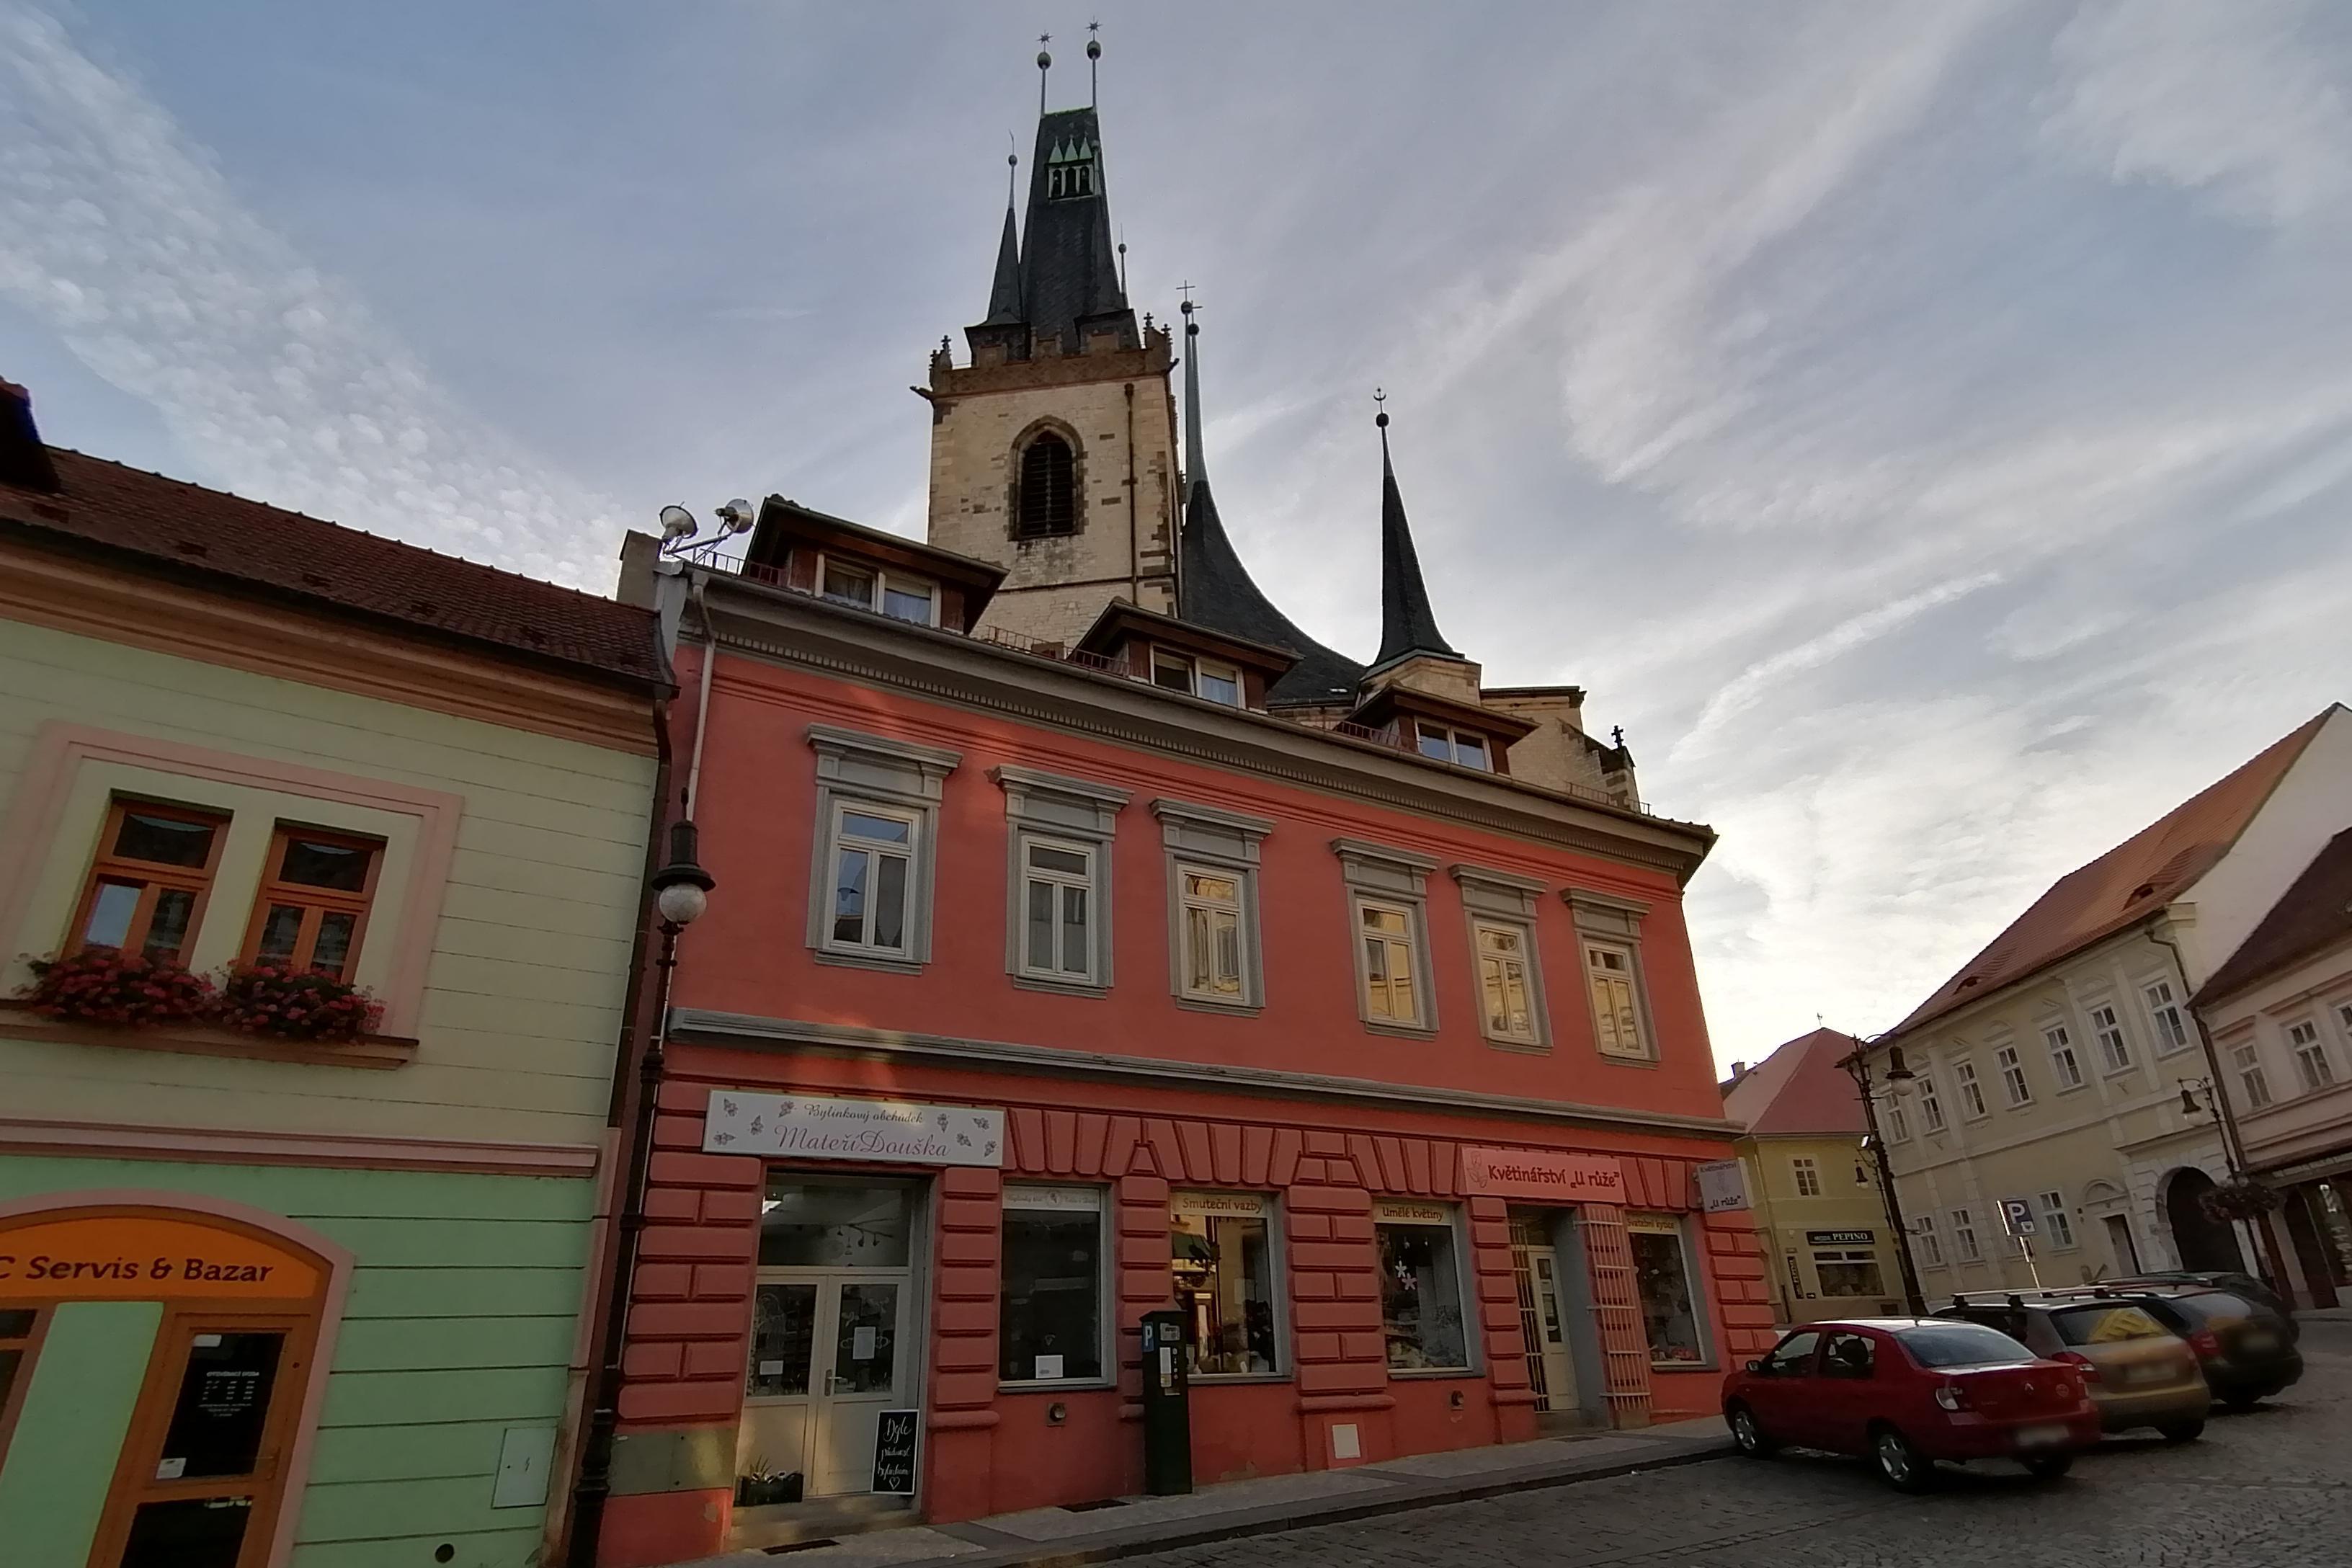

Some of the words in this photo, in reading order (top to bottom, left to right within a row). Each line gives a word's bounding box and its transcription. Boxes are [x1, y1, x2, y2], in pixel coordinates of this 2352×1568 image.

[804, 1103, 869, 1123] Bylinkový
[872, 1108, 923, 1124] obchůdek
[1487, 1164, 1567, 1184] Květinářství
[1182, 1198, 1231, 1210] Smuteční
[1233, 1199, 1263, 1214] vazby
[1382, 1206, 1411, 1219] Umělé
[1412, 1206, 1444, 1223] květiny
[2006, 1203, 2026, 1225] P
[1832, 1232, 1868, 1241] PEPINO
[25, 1255, 139, 1280] Servis
[149, 1257, 173, 1280] &
[182, 1258, 275, 1283] Bazar
[1144, 1324, 1153, 1348] P
